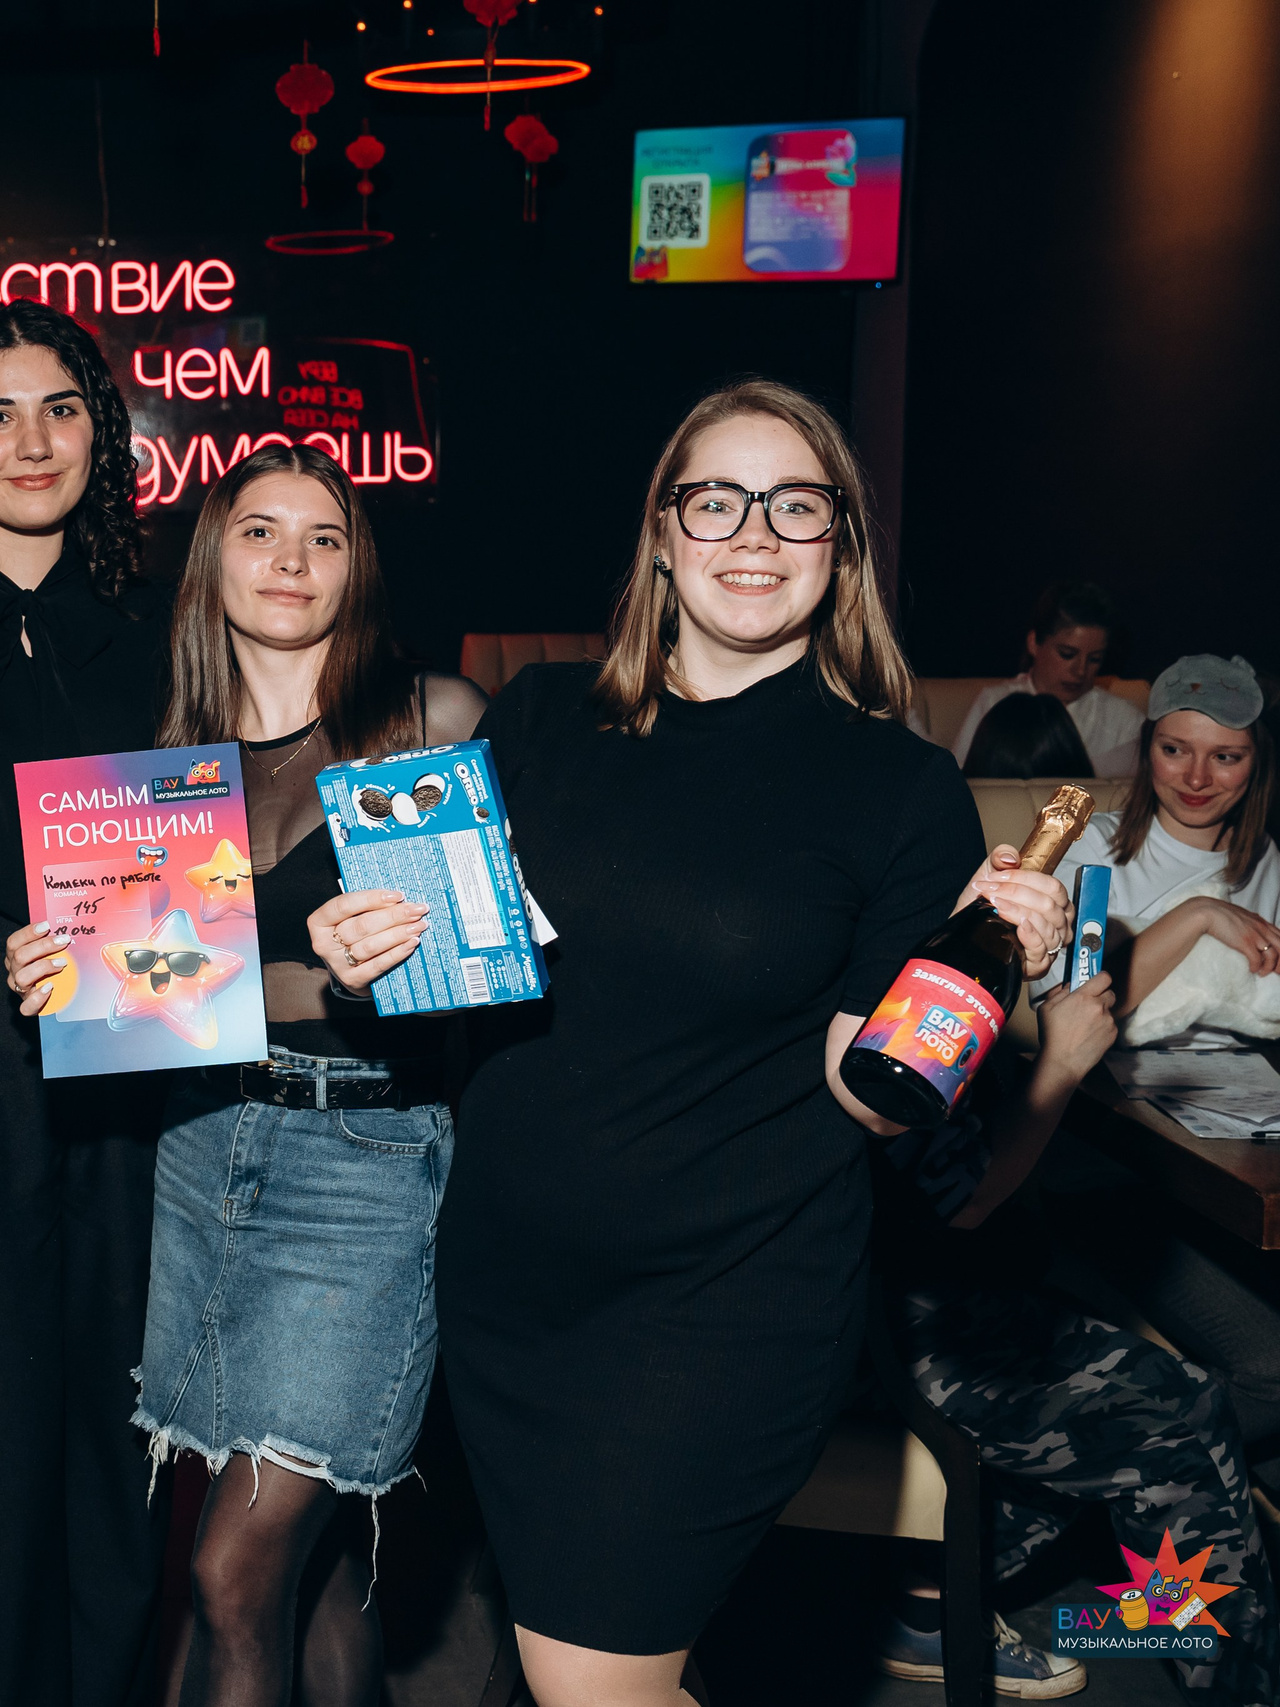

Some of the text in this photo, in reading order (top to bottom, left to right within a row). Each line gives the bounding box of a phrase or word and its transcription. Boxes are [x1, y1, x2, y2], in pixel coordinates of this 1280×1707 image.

[132, 345, 270, 400] чем
[38, 784, 149, 815] САМЫМ
[154, 778, 179, 791] ВАУ
[155, 786, 228, 800] МУЗЫКАЛЬНОЕ ЛОТО
[455, 762, 479, 807] OREO
[42, 811, 214, 849] ПОЮЩИМ!
[53, 889, 89, 898] КОМАНДА
[101, 876, 117, 886] по
[55, 916, 74, 924] ИГРА
[72, 896, 106, 916] 145
[1078, 947, 1091, 988] REO
[911, 967, 966, 998] Зажгли
[965, 993, 992, 1020] этот
[926, 1008, 968, 1040] ВАУ
[914, 1027, 955, 1060] ЛОТО
